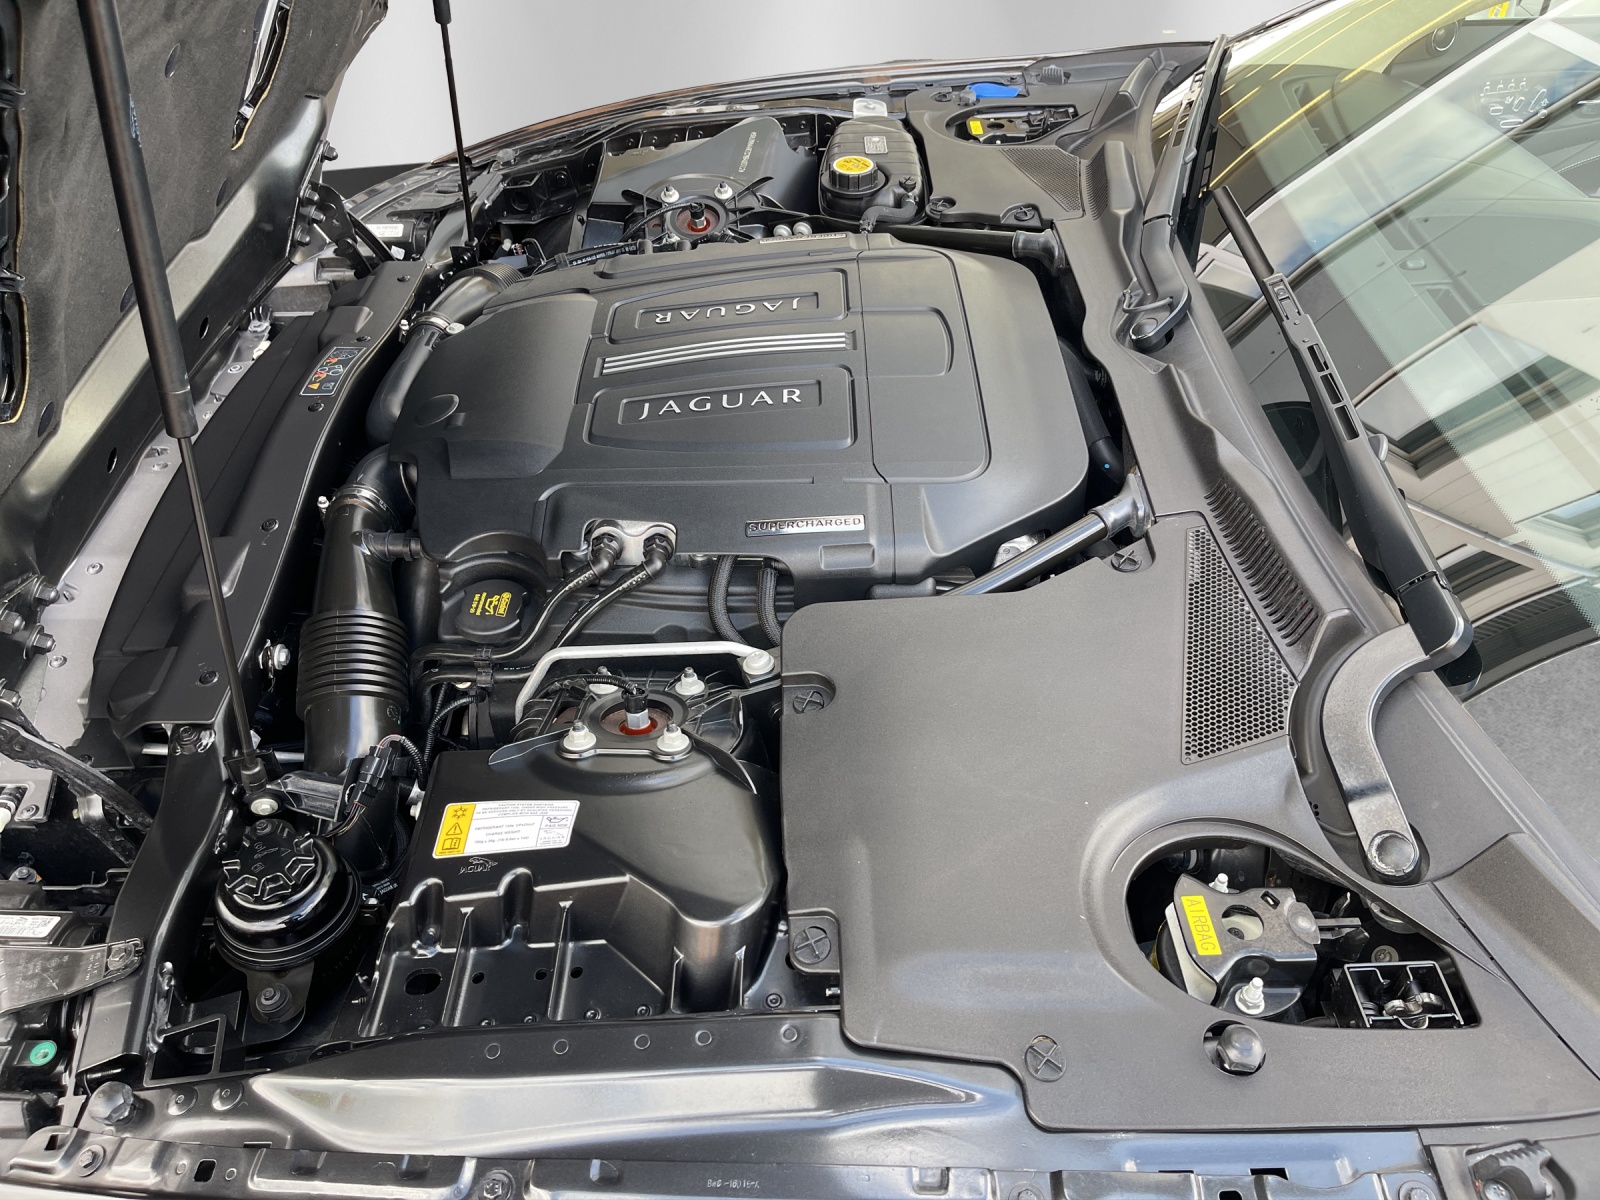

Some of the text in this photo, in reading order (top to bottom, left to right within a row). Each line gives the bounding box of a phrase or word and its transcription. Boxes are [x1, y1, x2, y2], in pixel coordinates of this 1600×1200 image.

[655, 297, 801, 324] JAGUAR
[638, 388, 802, 420] JAGUAR
[748, 517, 861, 532] SUPERCHARGED
[1185, 898, 1217, 951] AIRBAG
